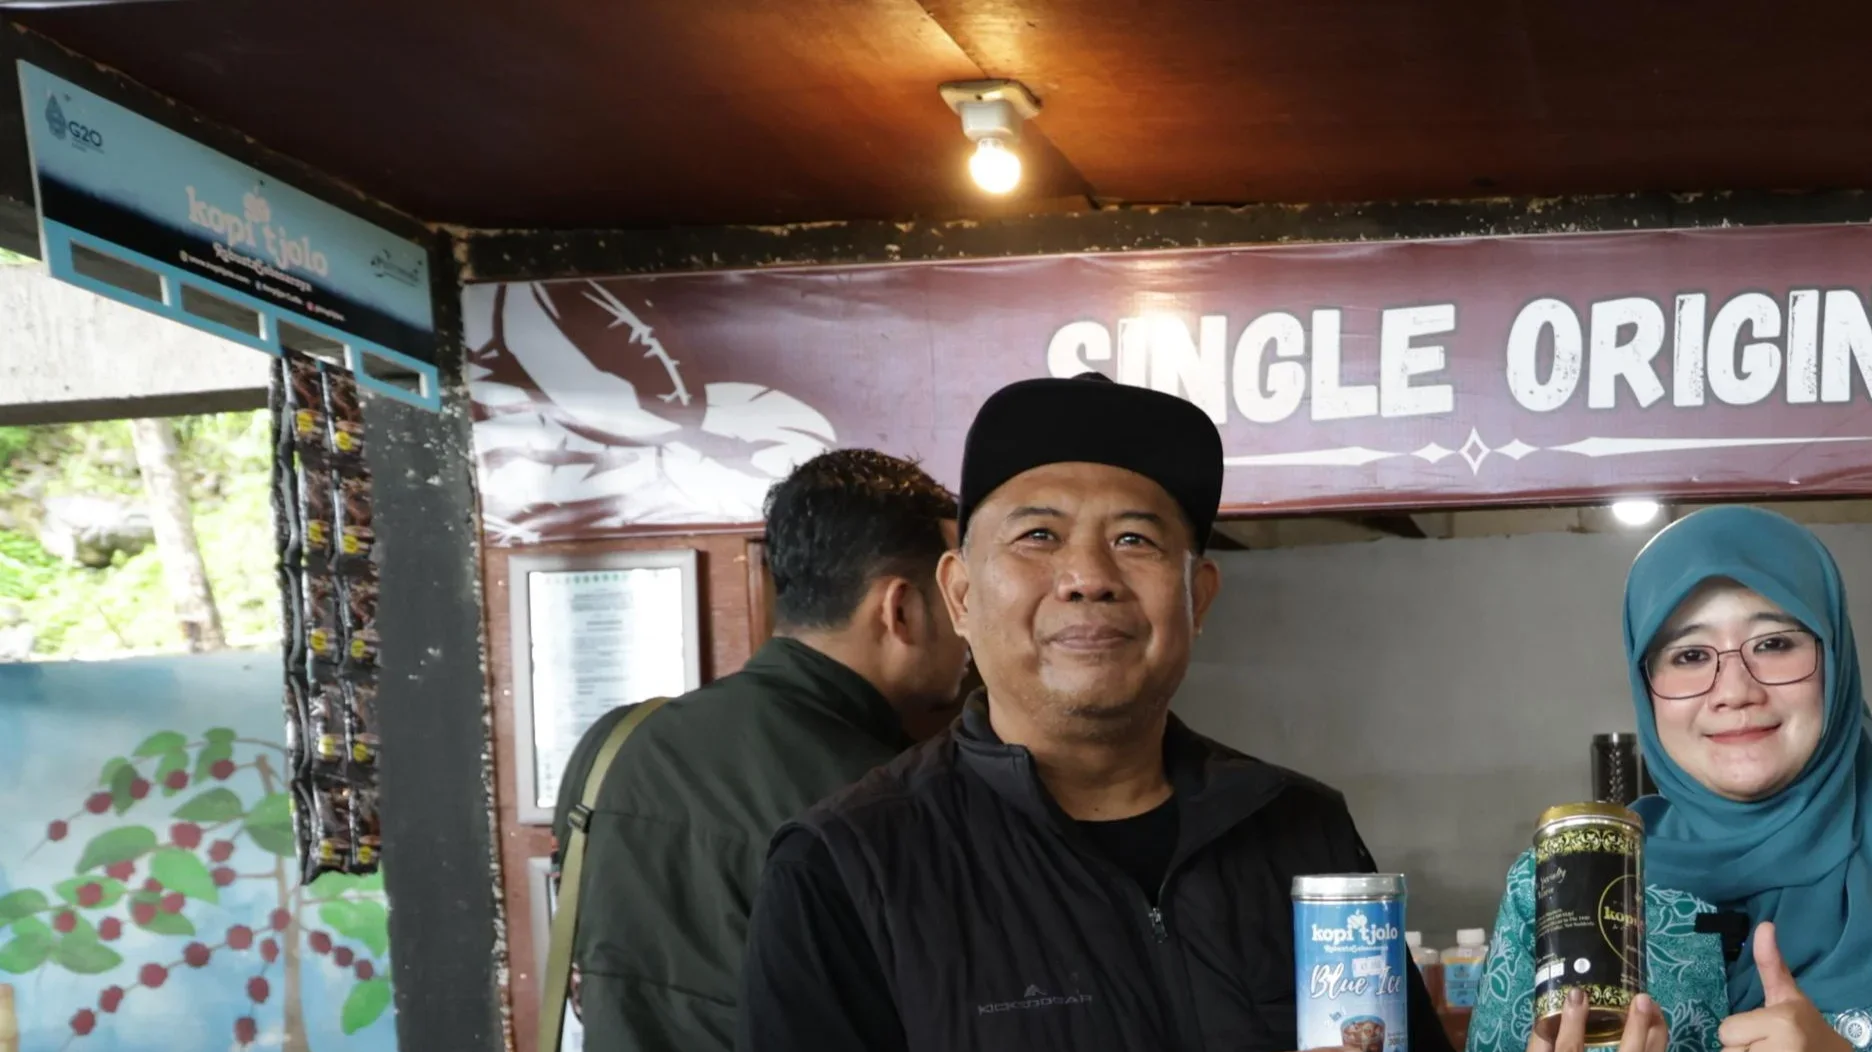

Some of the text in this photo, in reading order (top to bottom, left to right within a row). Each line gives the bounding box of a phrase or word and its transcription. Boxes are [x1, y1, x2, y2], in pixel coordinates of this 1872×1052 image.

[69, 121, 102, 147] G20
[186, 185, 257, 248] kopi
[263, 225, 328, 277] tjolo
[1047, 304, 1456, 424] SINGLE
[1311, 922, 1398, 945] kopi tjolo
[1310, 962, 1369, 1001] Blue
